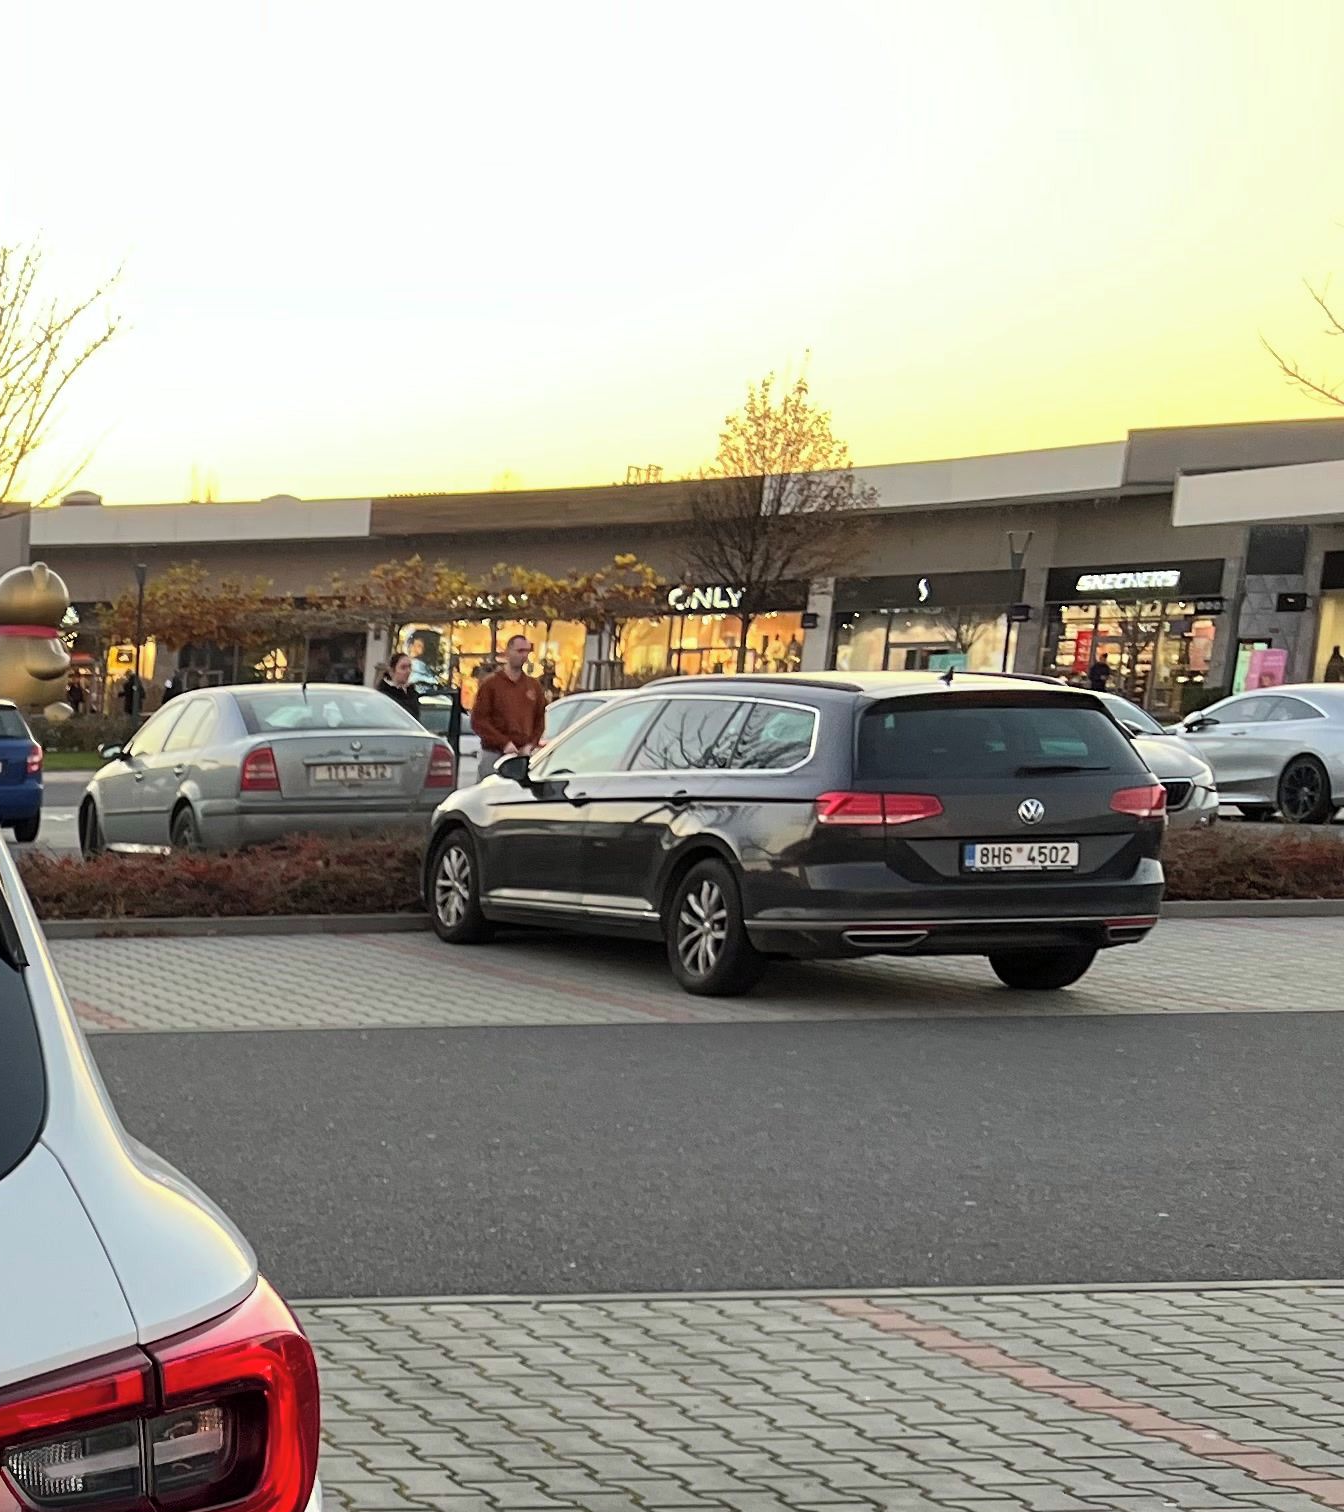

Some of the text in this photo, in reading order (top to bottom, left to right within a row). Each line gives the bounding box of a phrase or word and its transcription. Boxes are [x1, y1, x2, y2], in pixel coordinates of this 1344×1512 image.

[1076, 570, 1180, 592] SKECHERS
[668, 586, 745, 611] ONLY
[980, 845, 1070, 865] 8H6 4502
